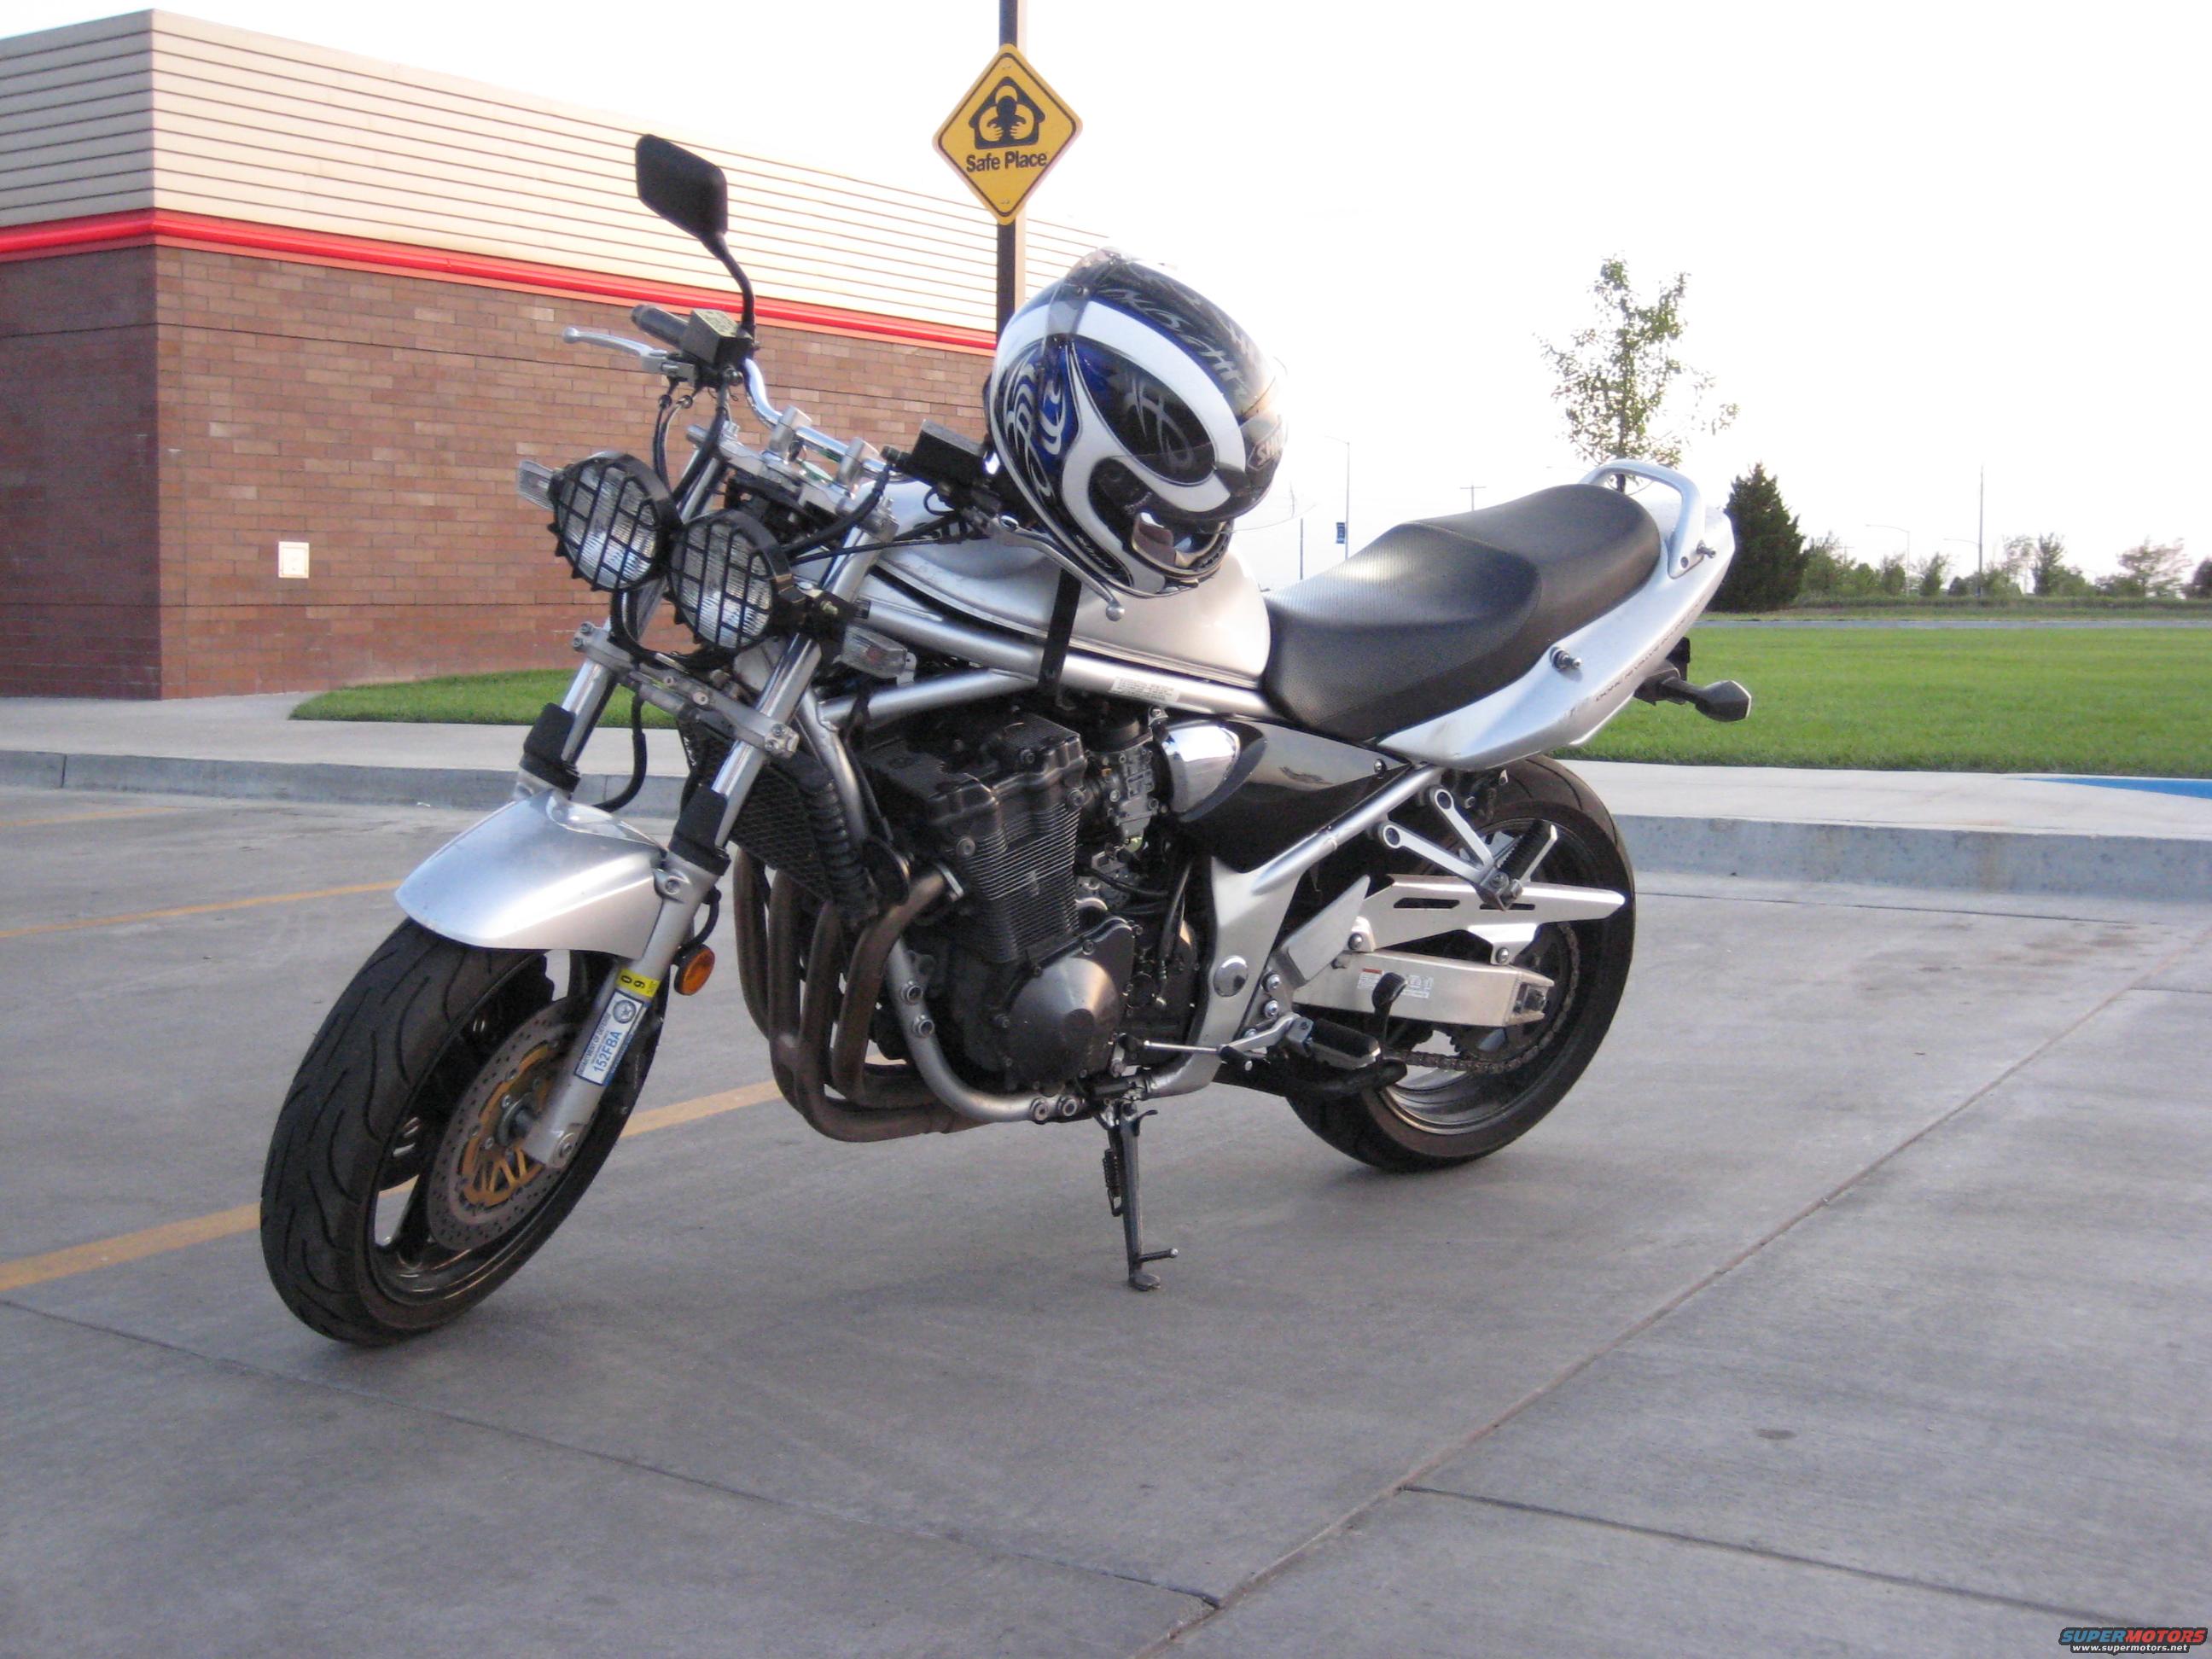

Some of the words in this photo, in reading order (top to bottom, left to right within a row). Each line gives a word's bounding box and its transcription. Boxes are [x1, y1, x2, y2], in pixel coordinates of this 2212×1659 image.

[966, 153, 1000, 172] Safe
[1004, 150, 1047, 170] Place
[593, 1029, 623, 1073] 152FBA
